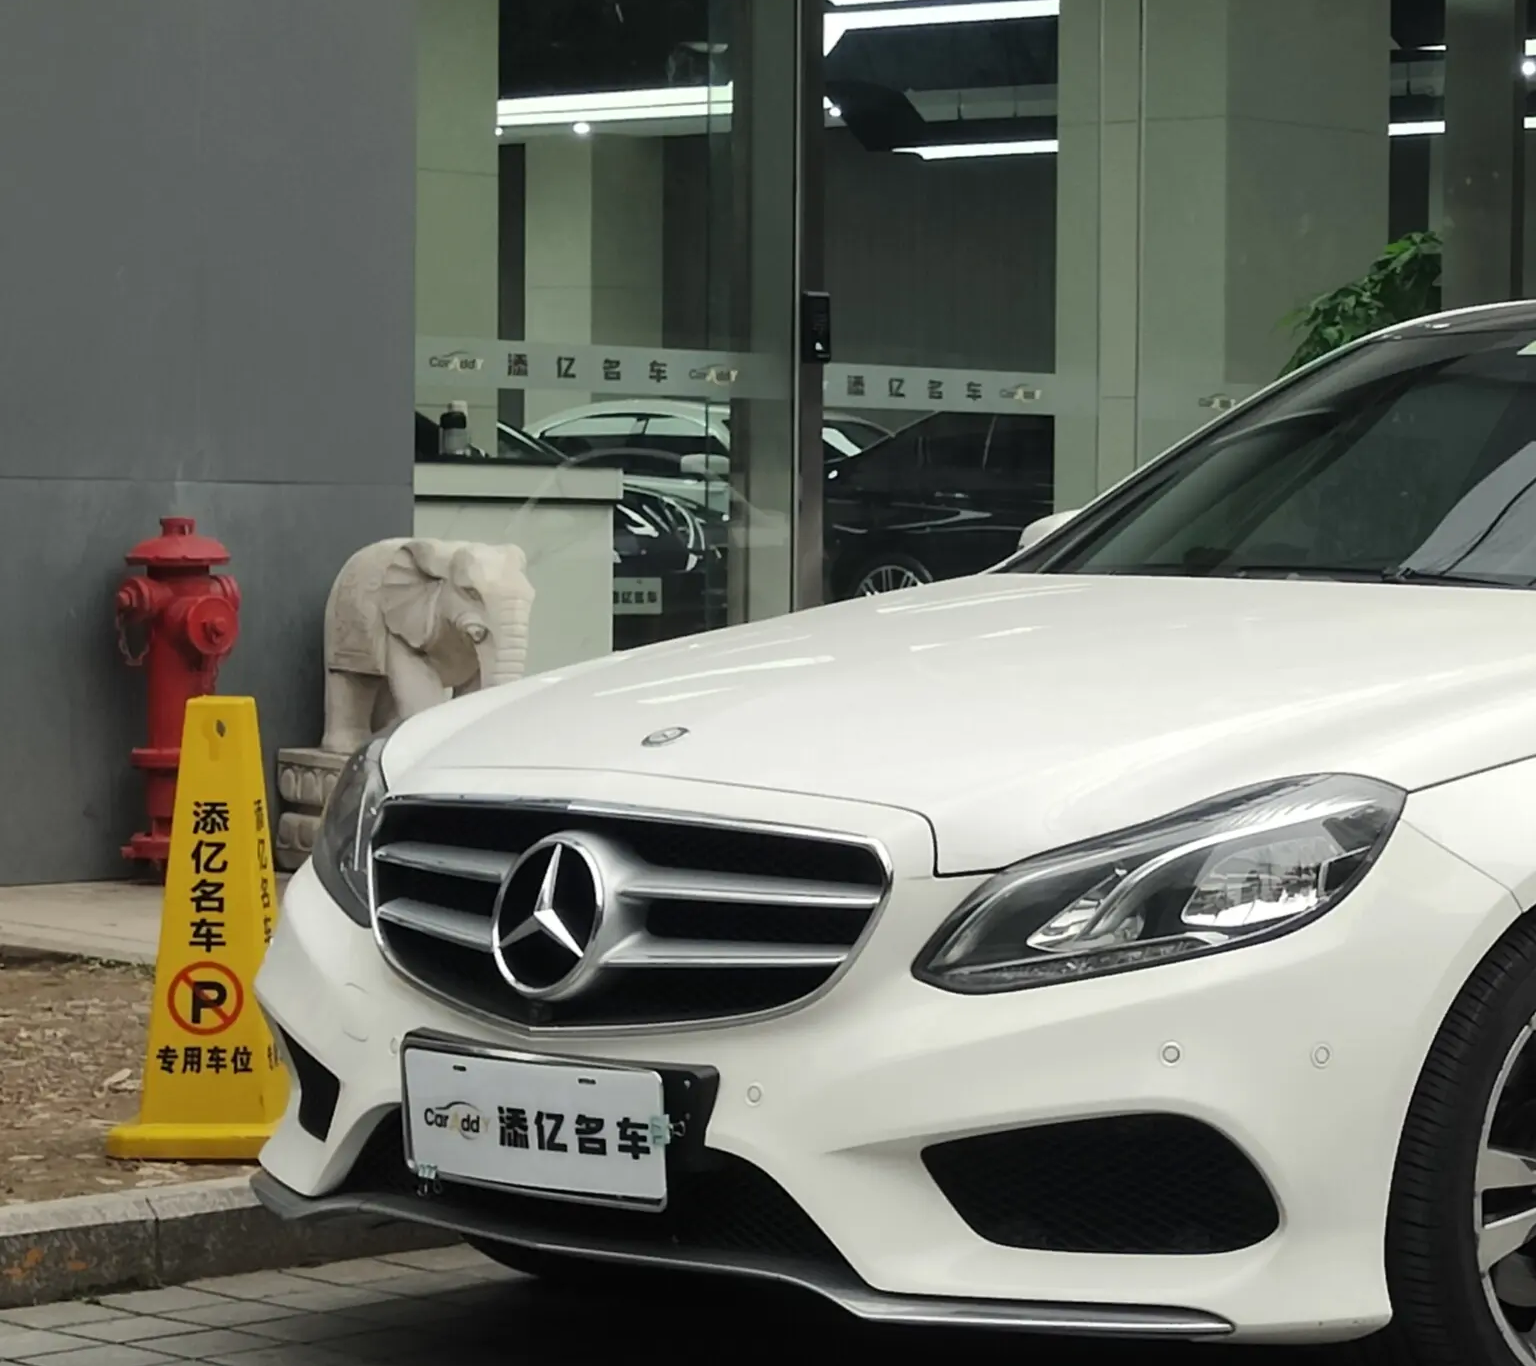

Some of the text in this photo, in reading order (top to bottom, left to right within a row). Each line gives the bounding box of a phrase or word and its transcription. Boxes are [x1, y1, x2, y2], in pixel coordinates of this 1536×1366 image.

[507, 352, 668, 383] 添亿名车
[188, 800, 230, 953] 添亿名车
[155, 1044, 253, 1074] 专用车位
[424, 1105, 651, 1160] CarAddY 添亿名车
